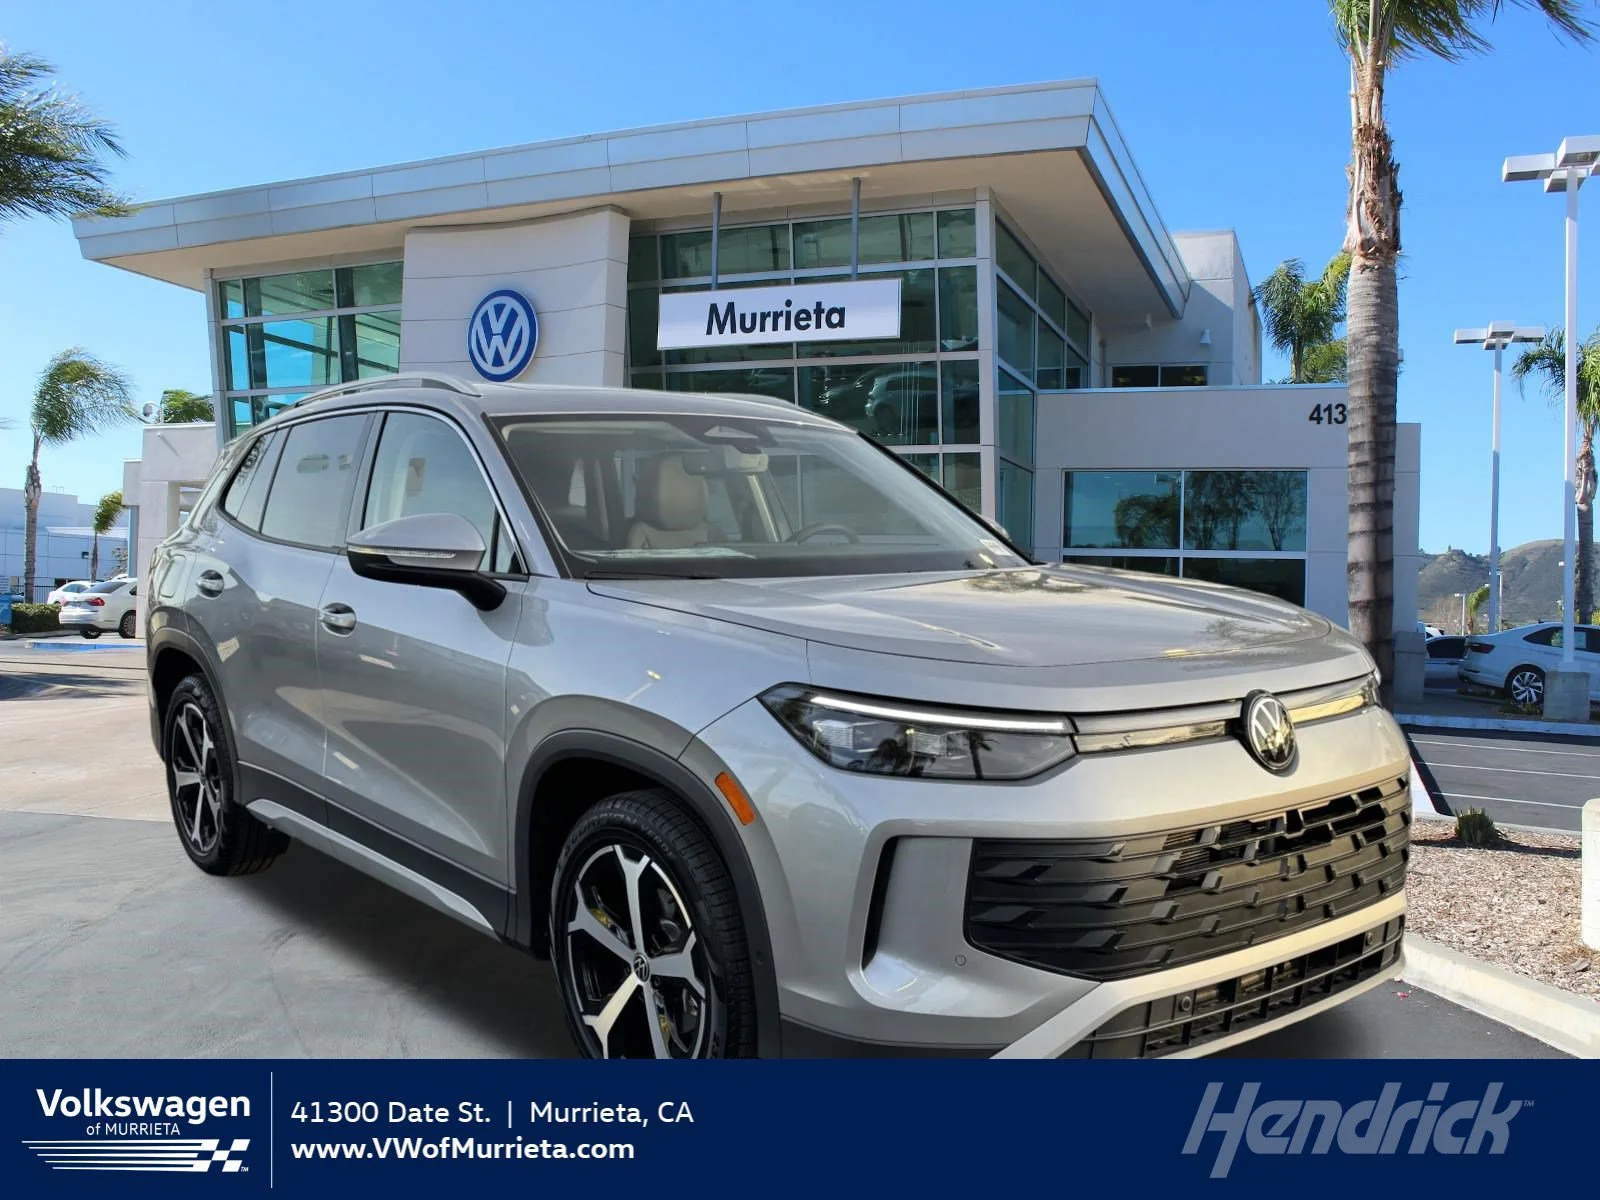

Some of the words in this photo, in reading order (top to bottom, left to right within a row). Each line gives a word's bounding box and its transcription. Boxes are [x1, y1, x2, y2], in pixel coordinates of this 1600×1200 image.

[470, 292, 534, 379] VW
[706, 299, 846, 336] Murrieta
[1308, 403, 1348, 425] 413
